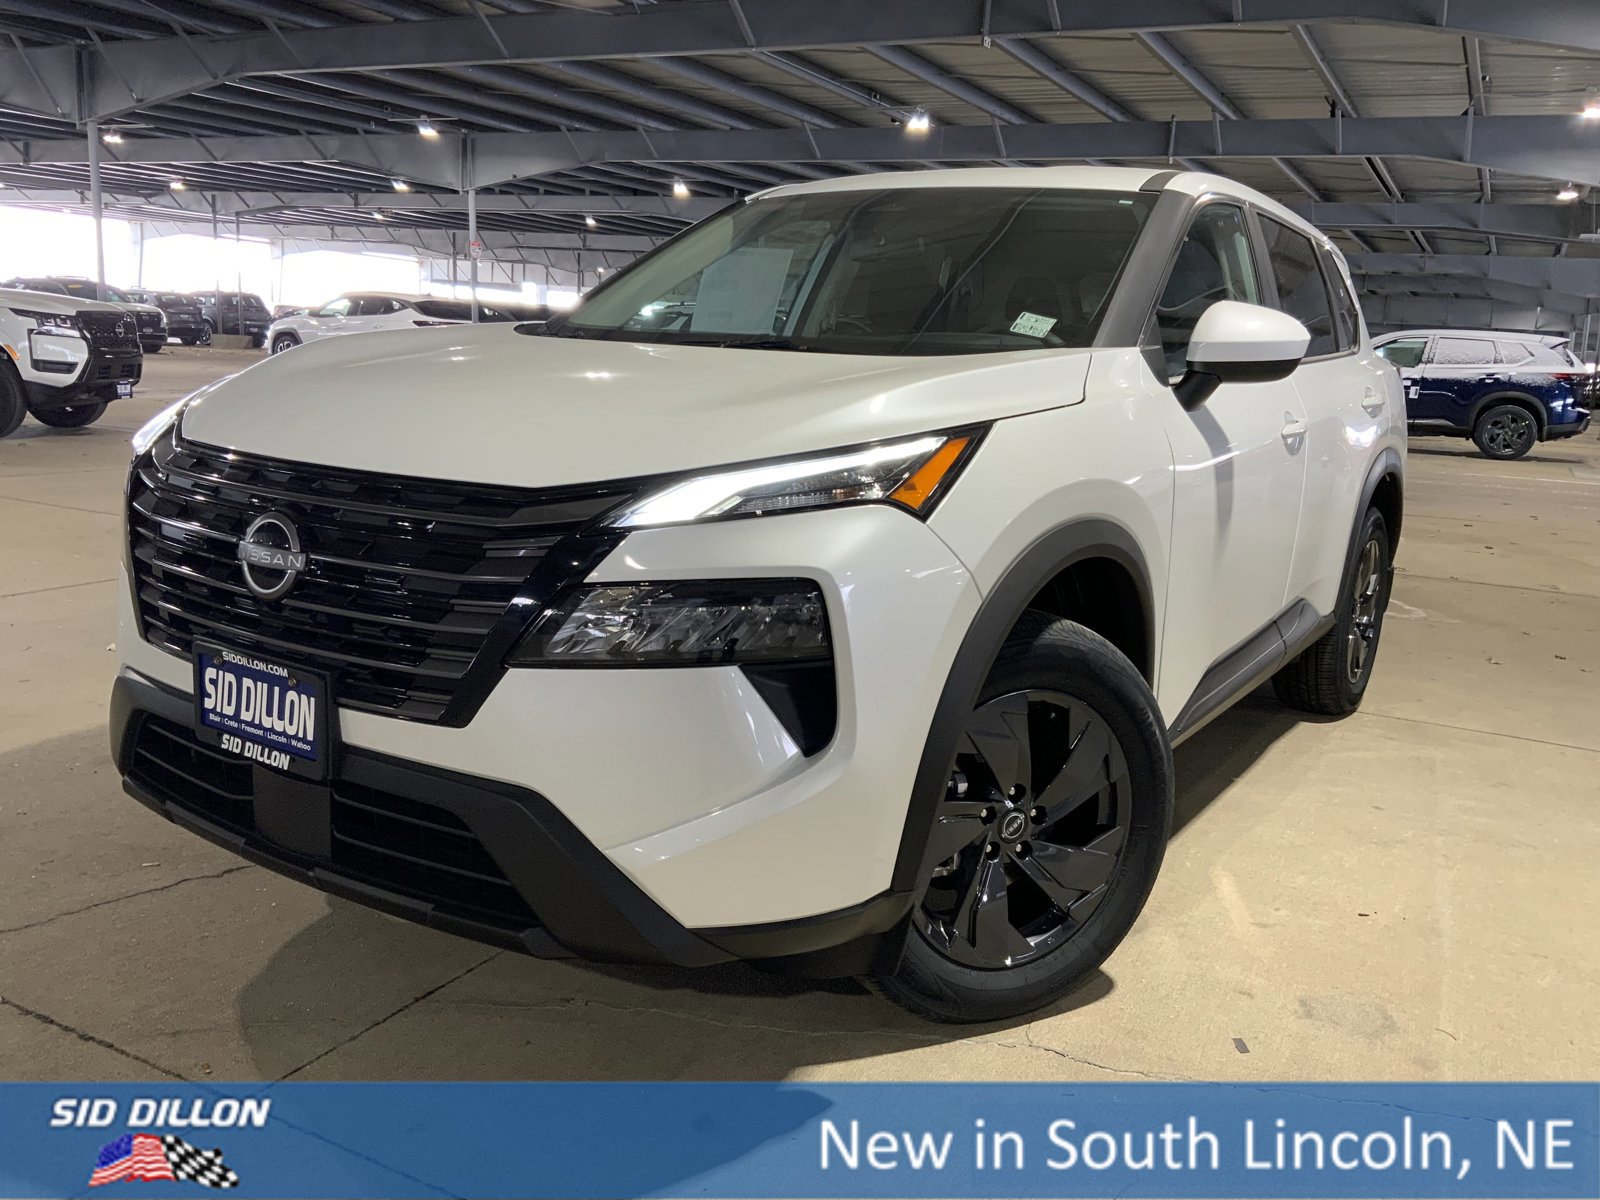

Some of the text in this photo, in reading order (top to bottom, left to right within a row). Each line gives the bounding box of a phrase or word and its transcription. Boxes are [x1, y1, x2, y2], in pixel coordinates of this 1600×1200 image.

[222, 651, 288, 677] SIDDILLON.COM
[204, 667, 315, 741] SID DILLON
[209, 713, 312, 751] Blair Crete Fremont Lincoln Wahoo
[221, 734, 291, 771] SID DILLON
